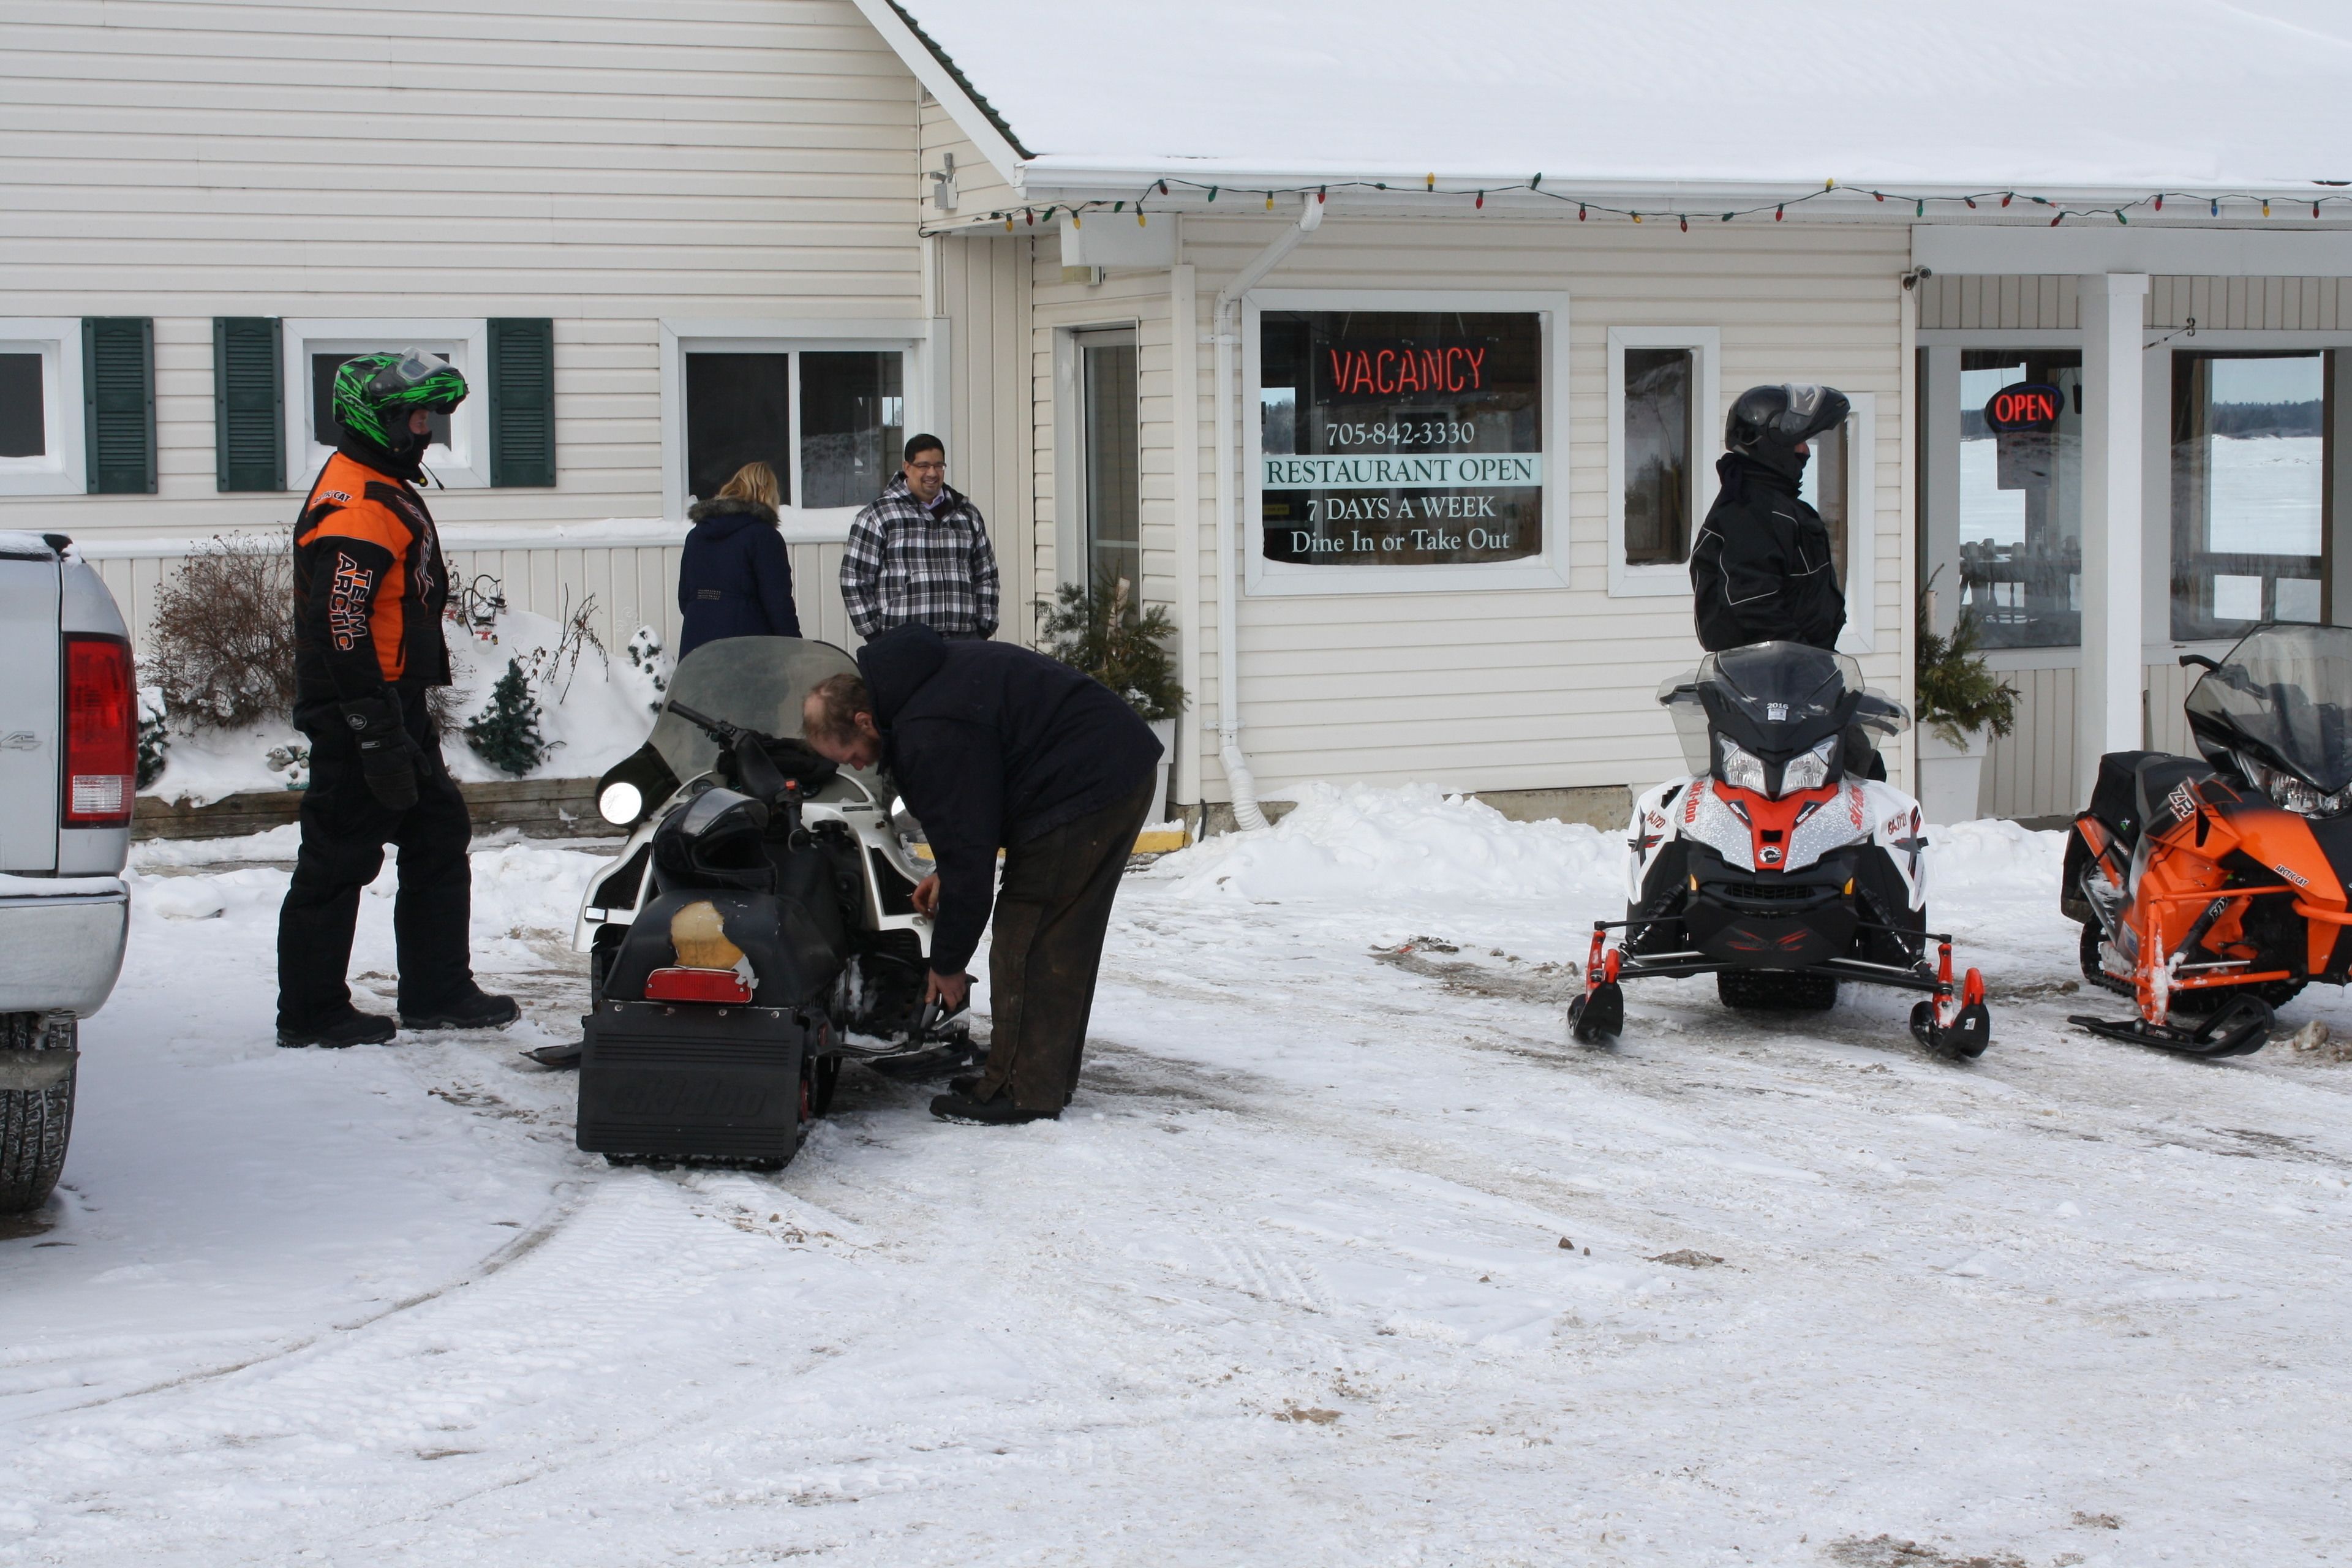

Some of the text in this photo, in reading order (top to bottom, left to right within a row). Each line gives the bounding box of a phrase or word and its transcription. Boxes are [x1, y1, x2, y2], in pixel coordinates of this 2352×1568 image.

[1330, 347, 1484, 394] VACANCY
[1995, 394, 2054, 422] OPEN
[1327, 422, 1475, 446] 705-842-3330
[1266, 459, 1532, 483] RESTAURANT OPEN
[333, 491, 352, 502] CAT
[1306, 500, 1317, 521] 7
[1325, 497, 1390, 520] DAYS
[1396, 497, 1415, 519] A
[1420, 496, 1497, 518] WEEK
[1291, 527, 1510, 552] Dine In or Take Out
[330, 552, 357, 650] ARCTIC
[349, 570, 373, 637] TEAM
[2168, 783, 2196, 818] ZR
[2274, 864, 2309, 887] ARCTIC CAT
